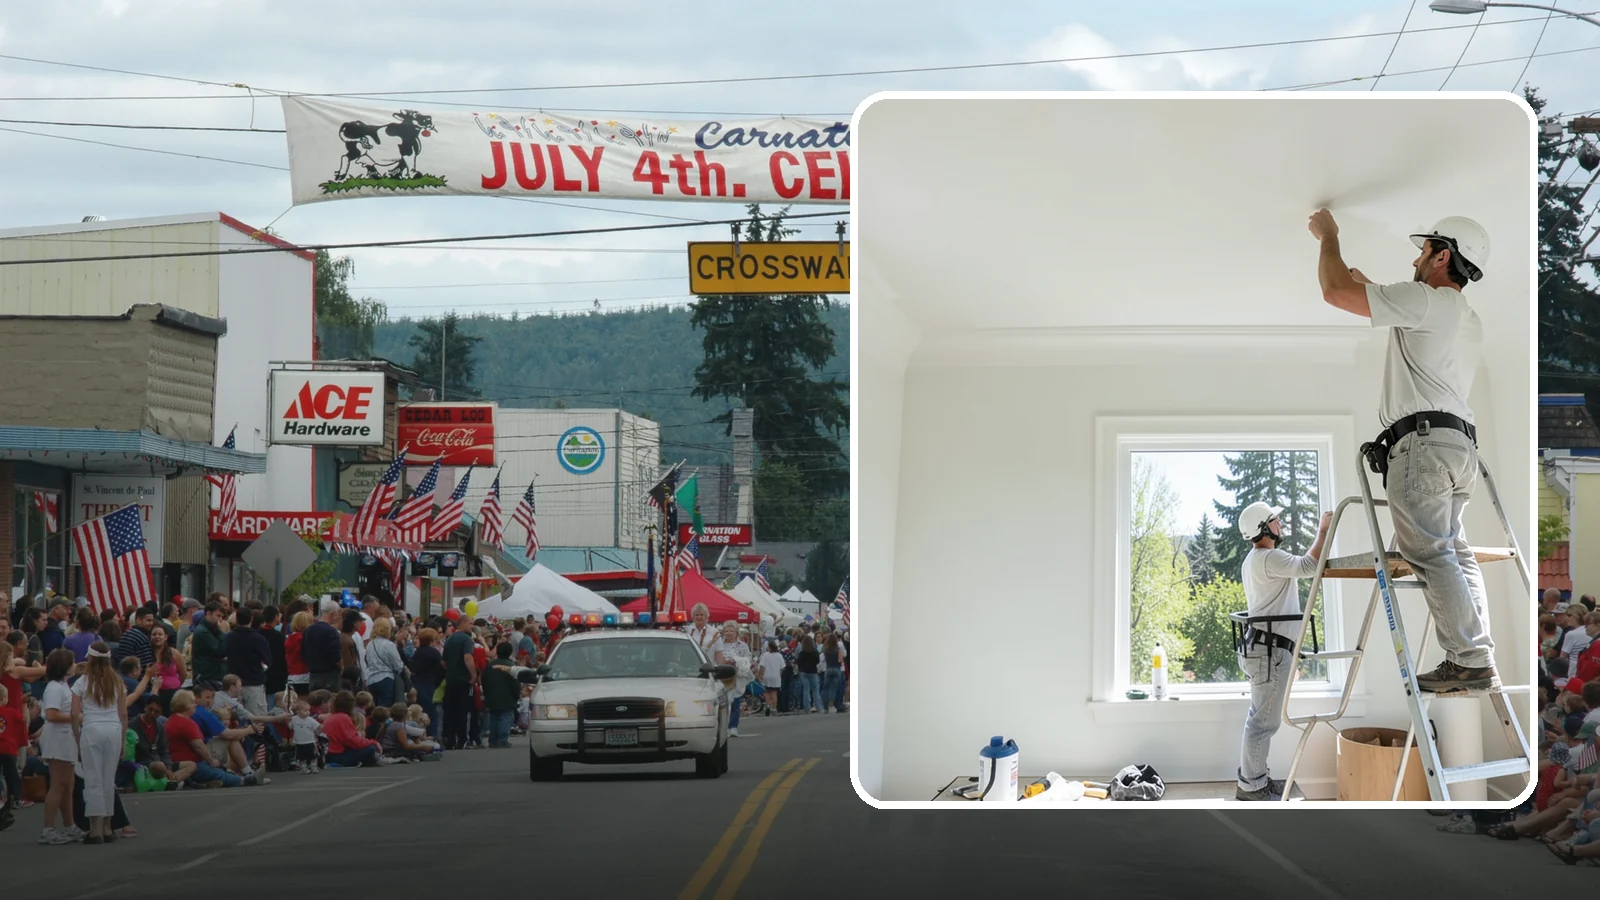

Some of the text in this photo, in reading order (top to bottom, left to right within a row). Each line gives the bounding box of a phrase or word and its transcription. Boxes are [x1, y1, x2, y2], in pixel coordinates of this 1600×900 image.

[481, 140, 605, 193] JULY
[632, 150, 747, 198] 4th.
[697, 254, 850, 280] CROSSWA
[282, 380, 374, 420] ACE
[406, 409, 452, 422] CEDAR
[283, 420, 371, 437] Hardware
[416, 428, 477, 447] Coca-Cola
[353, 466, 386, 480] Simpl
[96, 485, 124, 495] Vincent
[126, 485, 136, 495] de
[138, 485, 155, 495] Paul
[688, 526, 742, 535] CRNATION
[699, 535, 730, 543] GLASS
